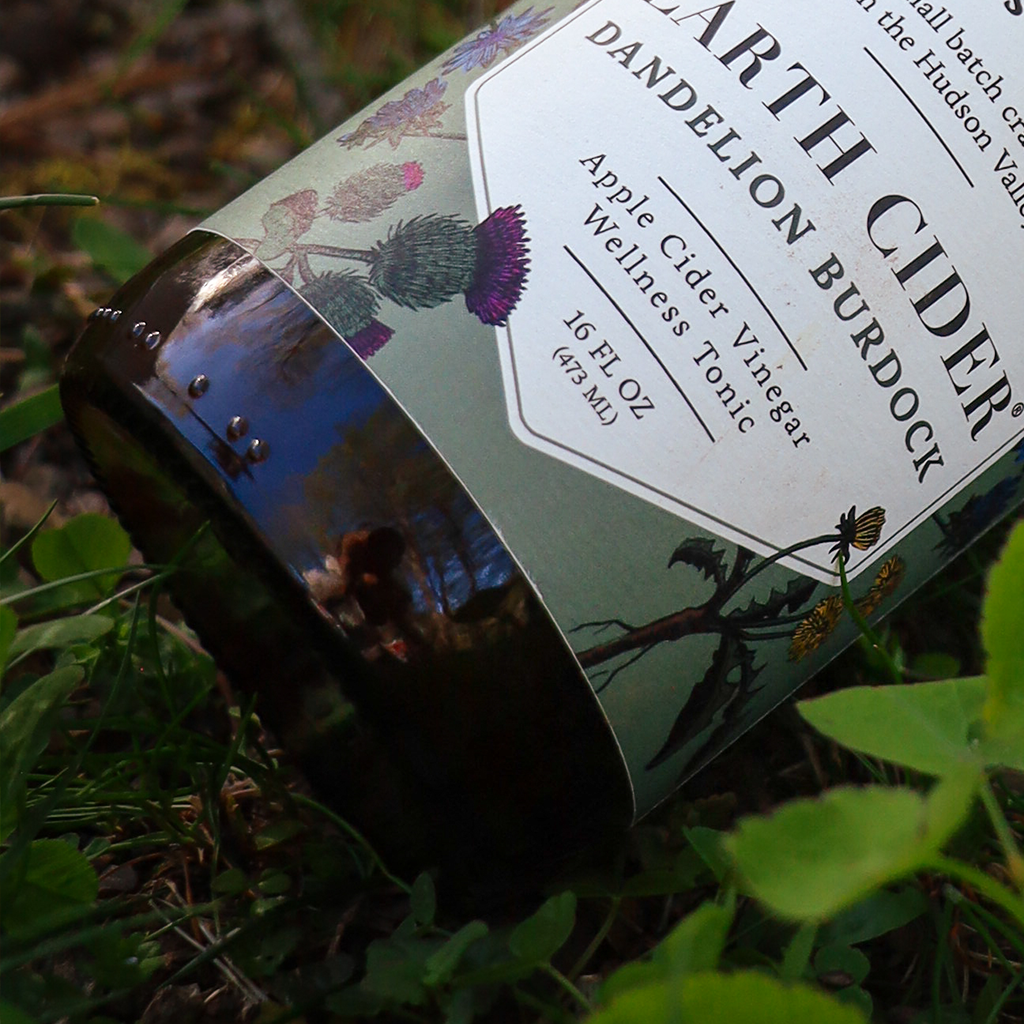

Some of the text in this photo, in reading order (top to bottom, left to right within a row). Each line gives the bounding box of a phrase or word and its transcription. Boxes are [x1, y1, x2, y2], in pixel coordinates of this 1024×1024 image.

[877, 11, 915, 51] the
[913, 49, 993, 152] Hudson
[946, 28, 1004, 103] batch
[579, 152, 811, 449] Apple Cider Vinegar
[582, 204, 755, 434] Wellness Tonic
[585, 20, 944, 483] DANDELION BURDOCK
[552, 346, 618, 426] (473 ML)
[563, 311, 655, 421] 16 FL OZ
